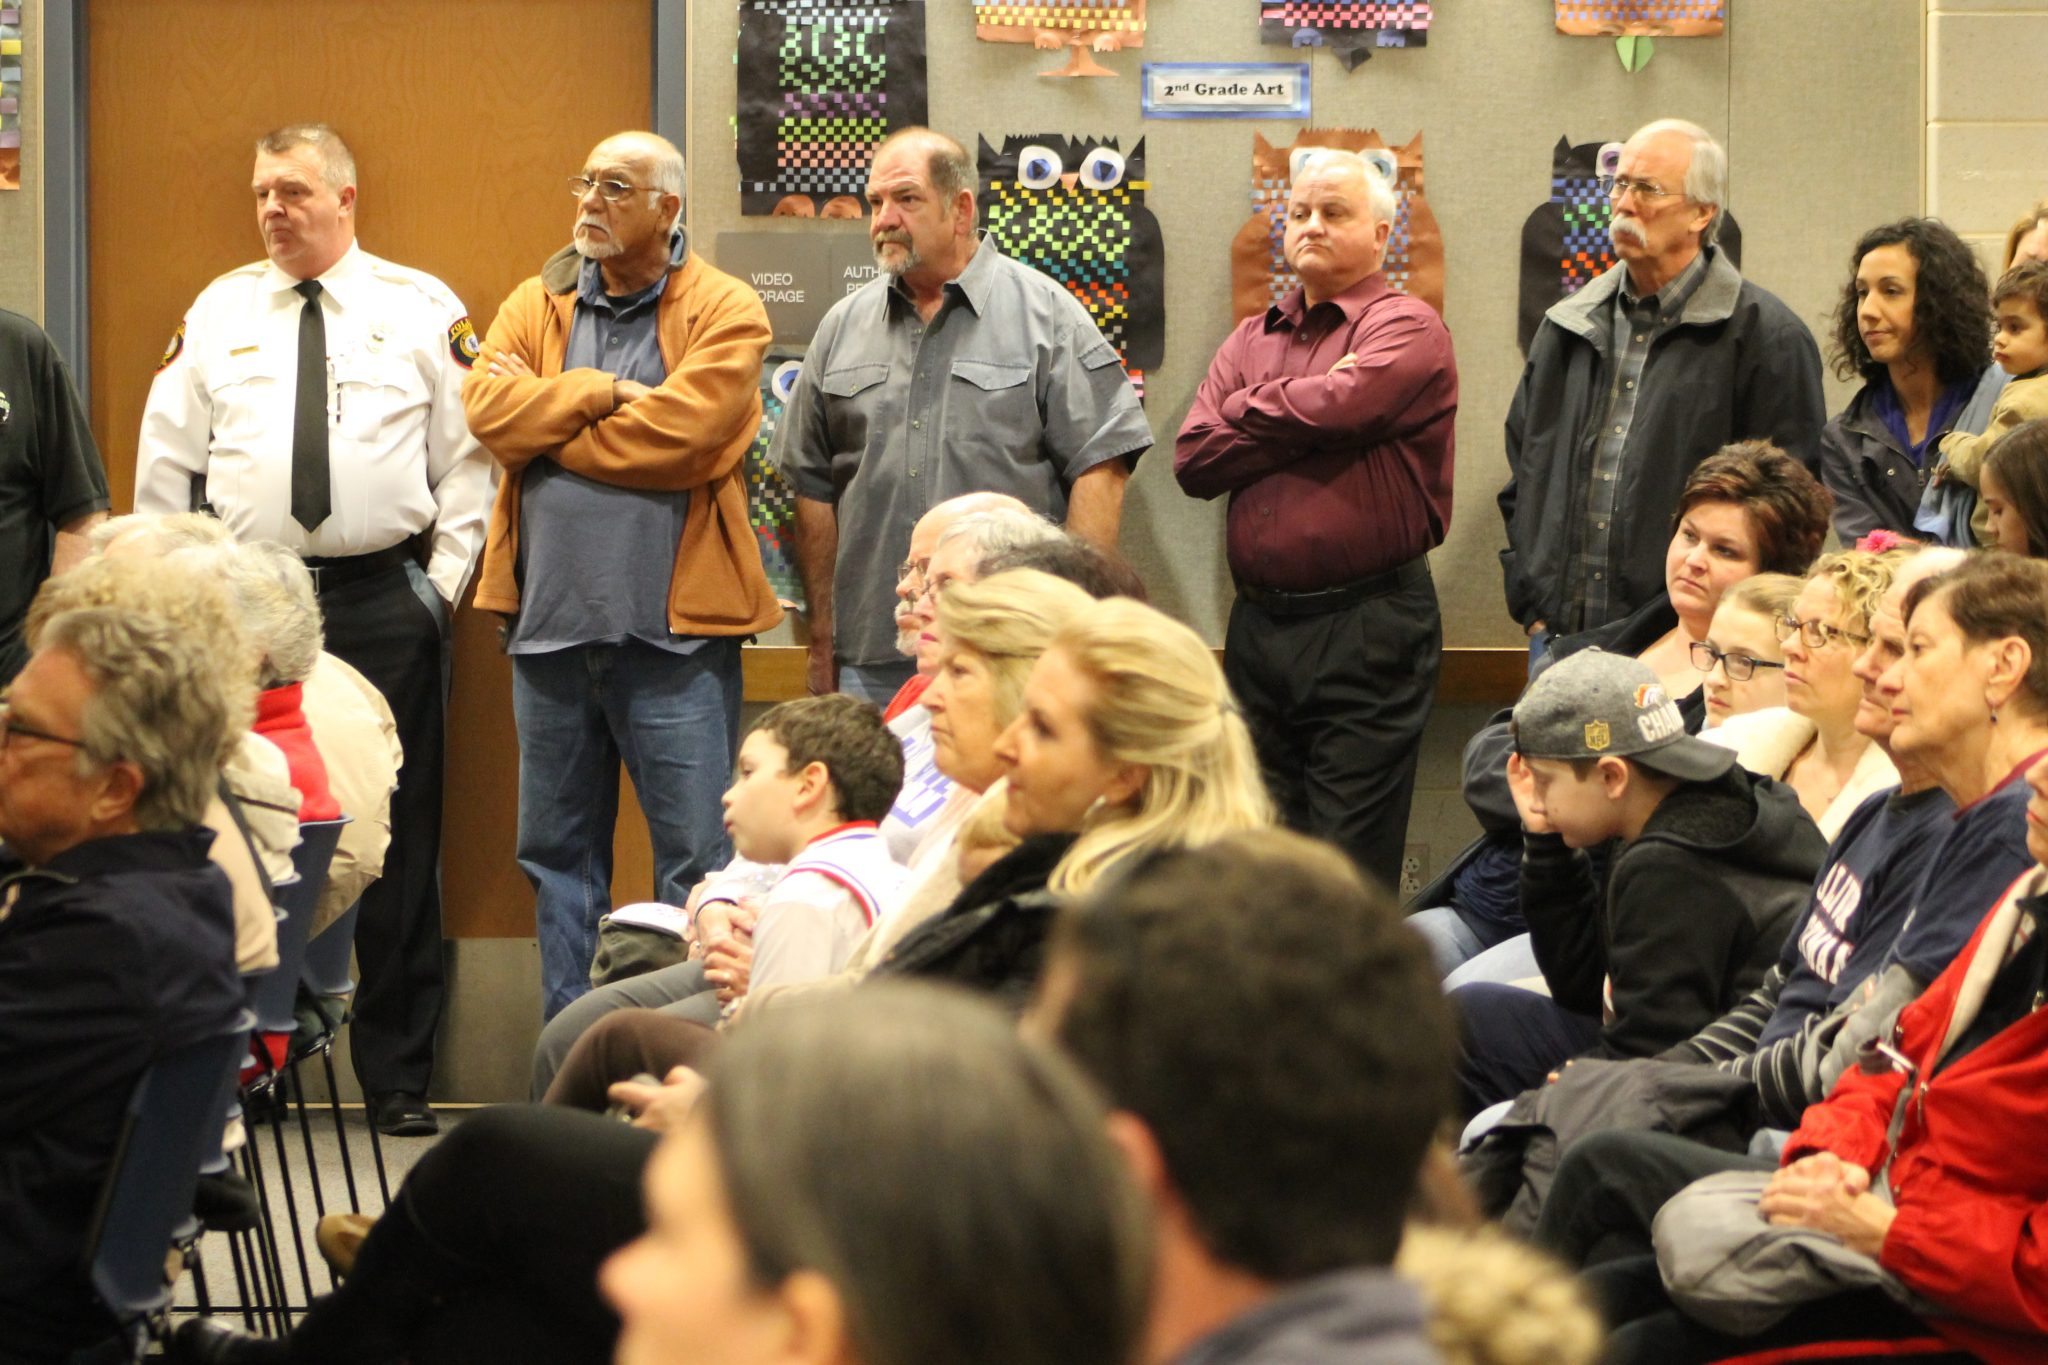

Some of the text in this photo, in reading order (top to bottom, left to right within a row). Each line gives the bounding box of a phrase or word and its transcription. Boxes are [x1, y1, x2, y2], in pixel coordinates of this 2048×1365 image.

[1164, 82, 1284, 96] 2nd Grade Art
[751, 272, 793, 286] VIDEO
[843, 266, 881, 278] AUTH
[757, 290, 805, 303] ORAGE
[1637, 700, 1685, 742] CHAM
